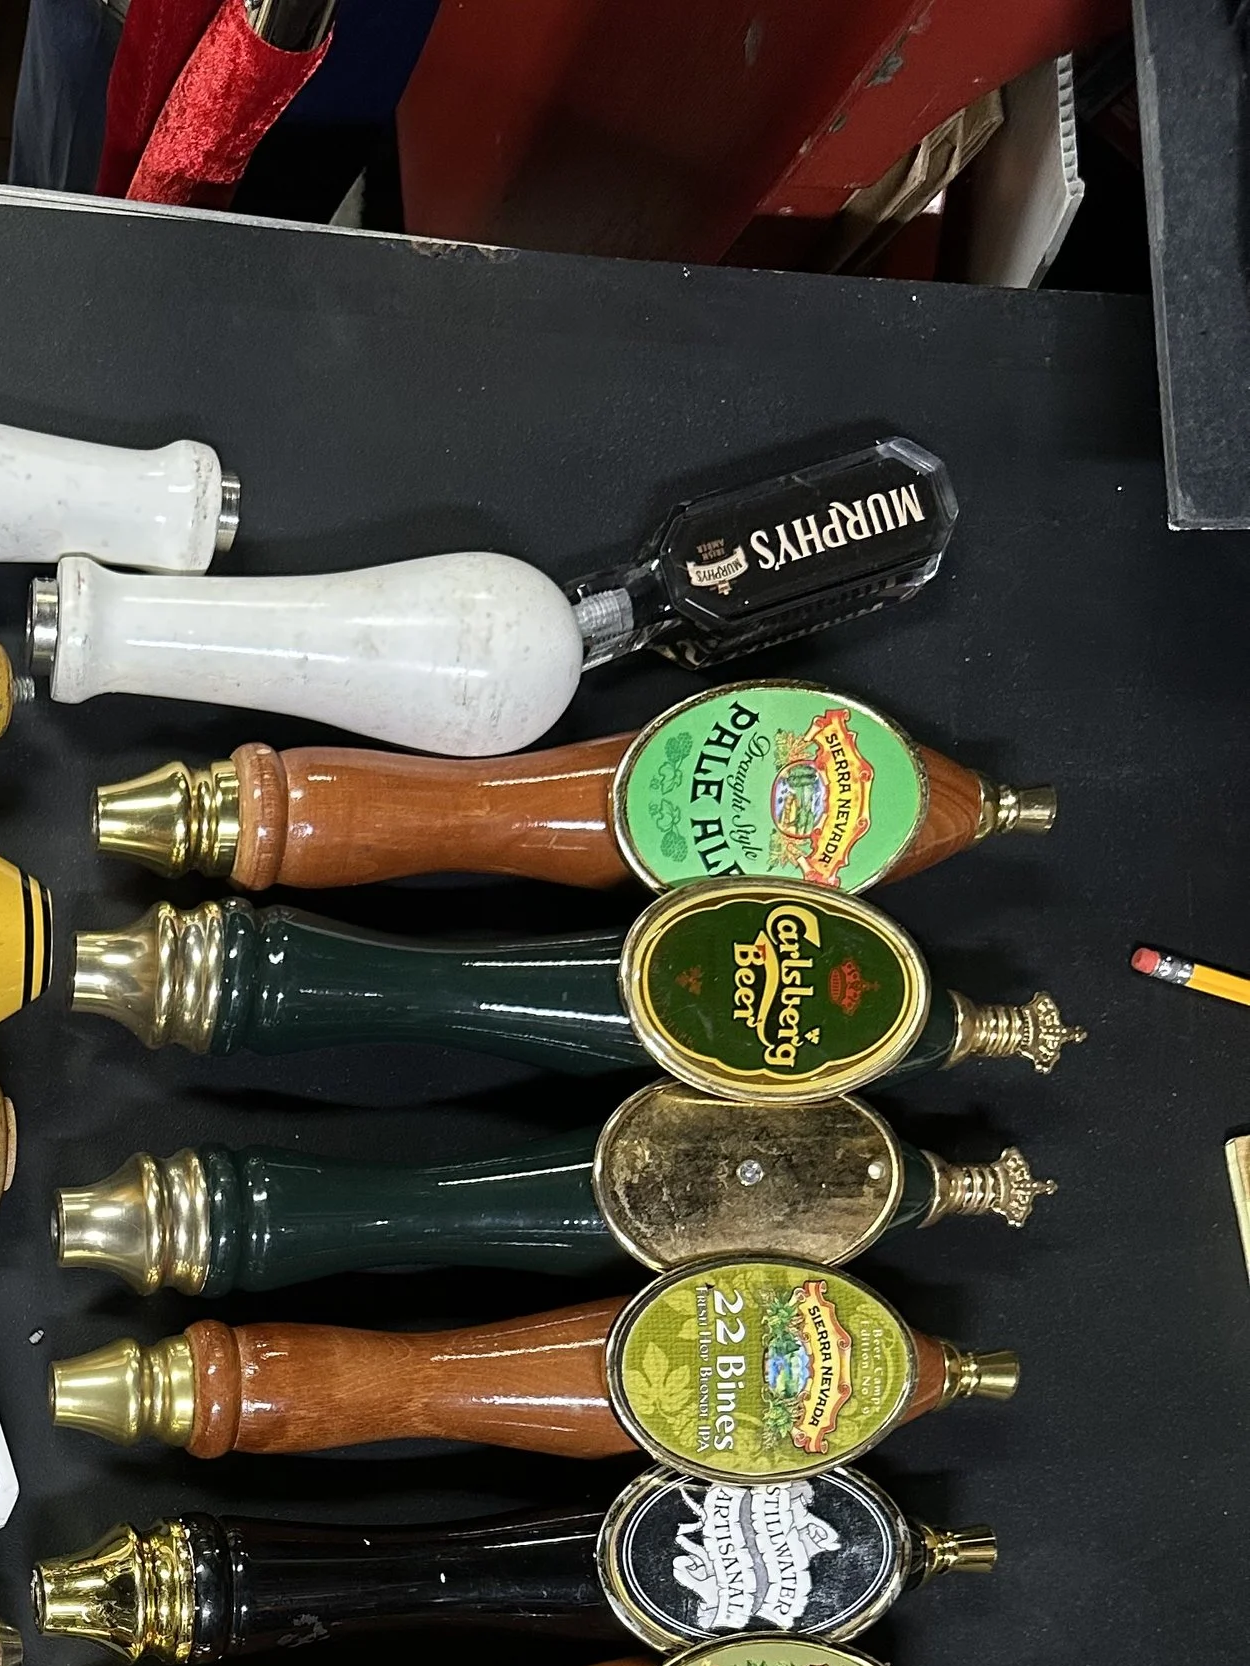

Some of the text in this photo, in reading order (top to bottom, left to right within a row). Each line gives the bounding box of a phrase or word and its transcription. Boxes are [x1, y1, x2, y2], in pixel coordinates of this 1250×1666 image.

[690, 700, 761, 804] PALE
[726, 731, 771, 861] Draught Style
[818, 732, 851, 864] SIERRA NEVADA
[733, 940, 764, 1029] Beer
[765, 904, 822, 1067] Carlsberg
[713, 1289, 746, 1451] 22 Bines
[807, 1305, 834, 1428] SIERRA NEVADA
[696, 1425, 710, 1453] IPA
[713, 1488, 744, 1618] ARTISANAL
[764, 1484, 798, 1617] STILLWATER
